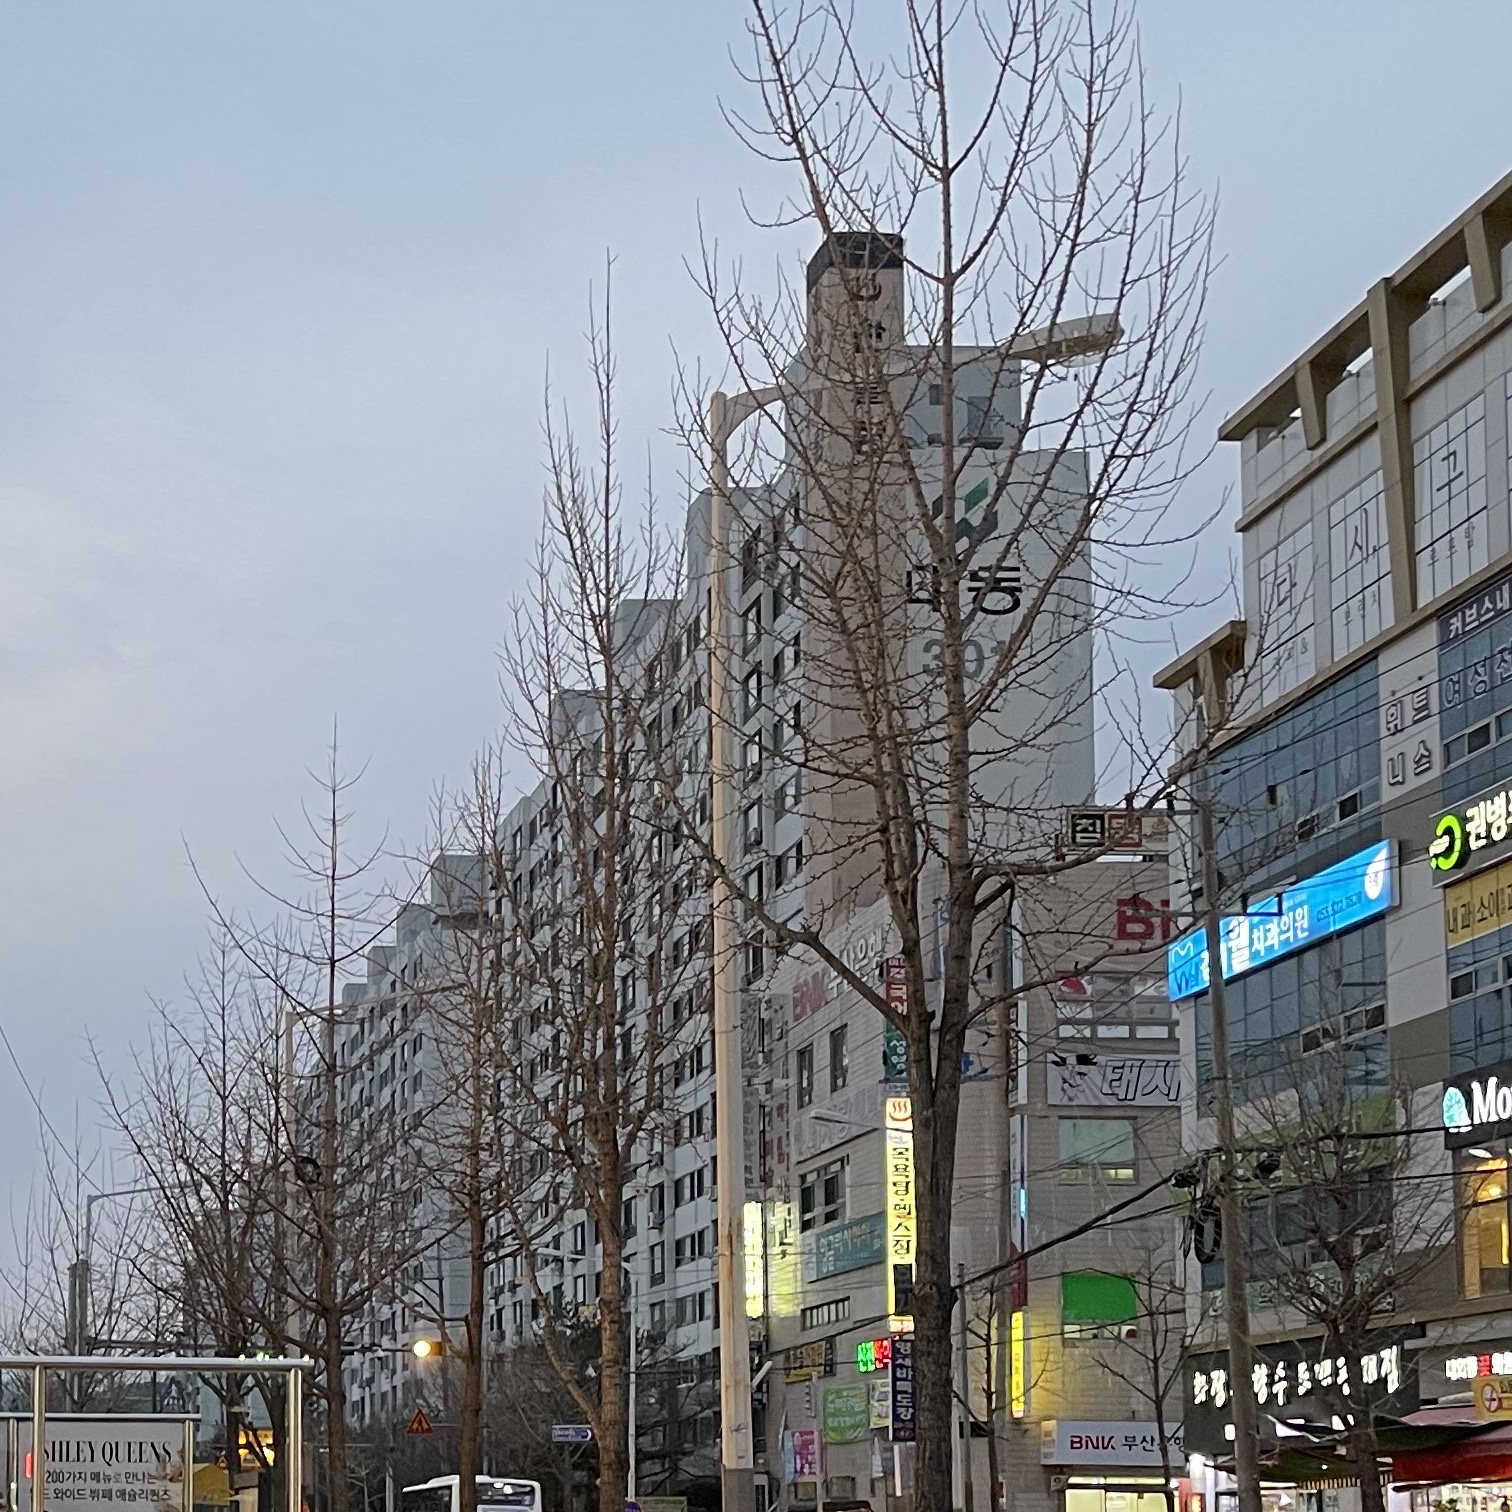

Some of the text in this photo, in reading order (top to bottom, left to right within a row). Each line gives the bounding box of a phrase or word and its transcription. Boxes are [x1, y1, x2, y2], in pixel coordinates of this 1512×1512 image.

[1464, 790, 1512, 851] 권병
[1252, 905, 1310, 957] 치과의원
[1471, 1076, 1512, 1125] Mo
[44, 1439, 172, 1467] SHLEY QUEENS
[1069, 1434, 1116, 1451] BNK
[45, 1471, 87, 1485] 200가지
[53, 1487, 88, 1502] 와이드
